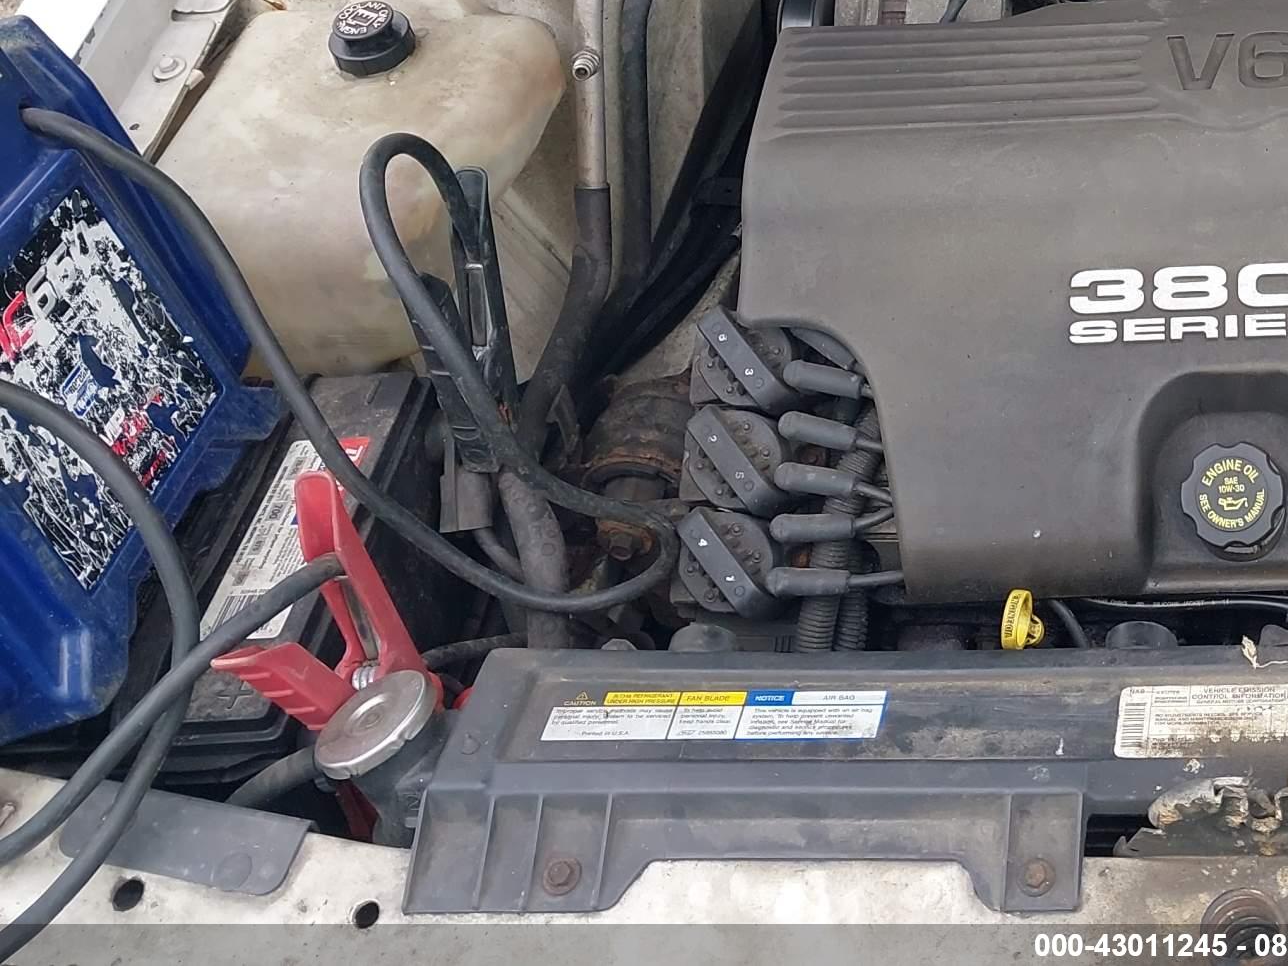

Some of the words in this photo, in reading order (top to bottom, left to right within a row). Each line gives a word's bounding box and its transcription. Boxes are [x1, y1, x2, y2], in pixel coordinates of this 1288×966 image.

[338, 1, 386, 20] COOLANT
[744, 368, 755, 376] 3
[1201, 458, 1243, 487] ENGINE
[1243, 464, 1259, 484] OIL
[1224, 476, 1239, 485] SAE
[1218, 484, 1245, 494] 10W-30
[268, 503, 284, 520] 700
[1199, 493, 1211, 513] SEE
[1207, 511, 1245, 529] OWNER'S
[1244, 488, 1265, 523] MANUAL
[822, 694, 840, 702] AIR
[840, 694, 857, 702] BAG
